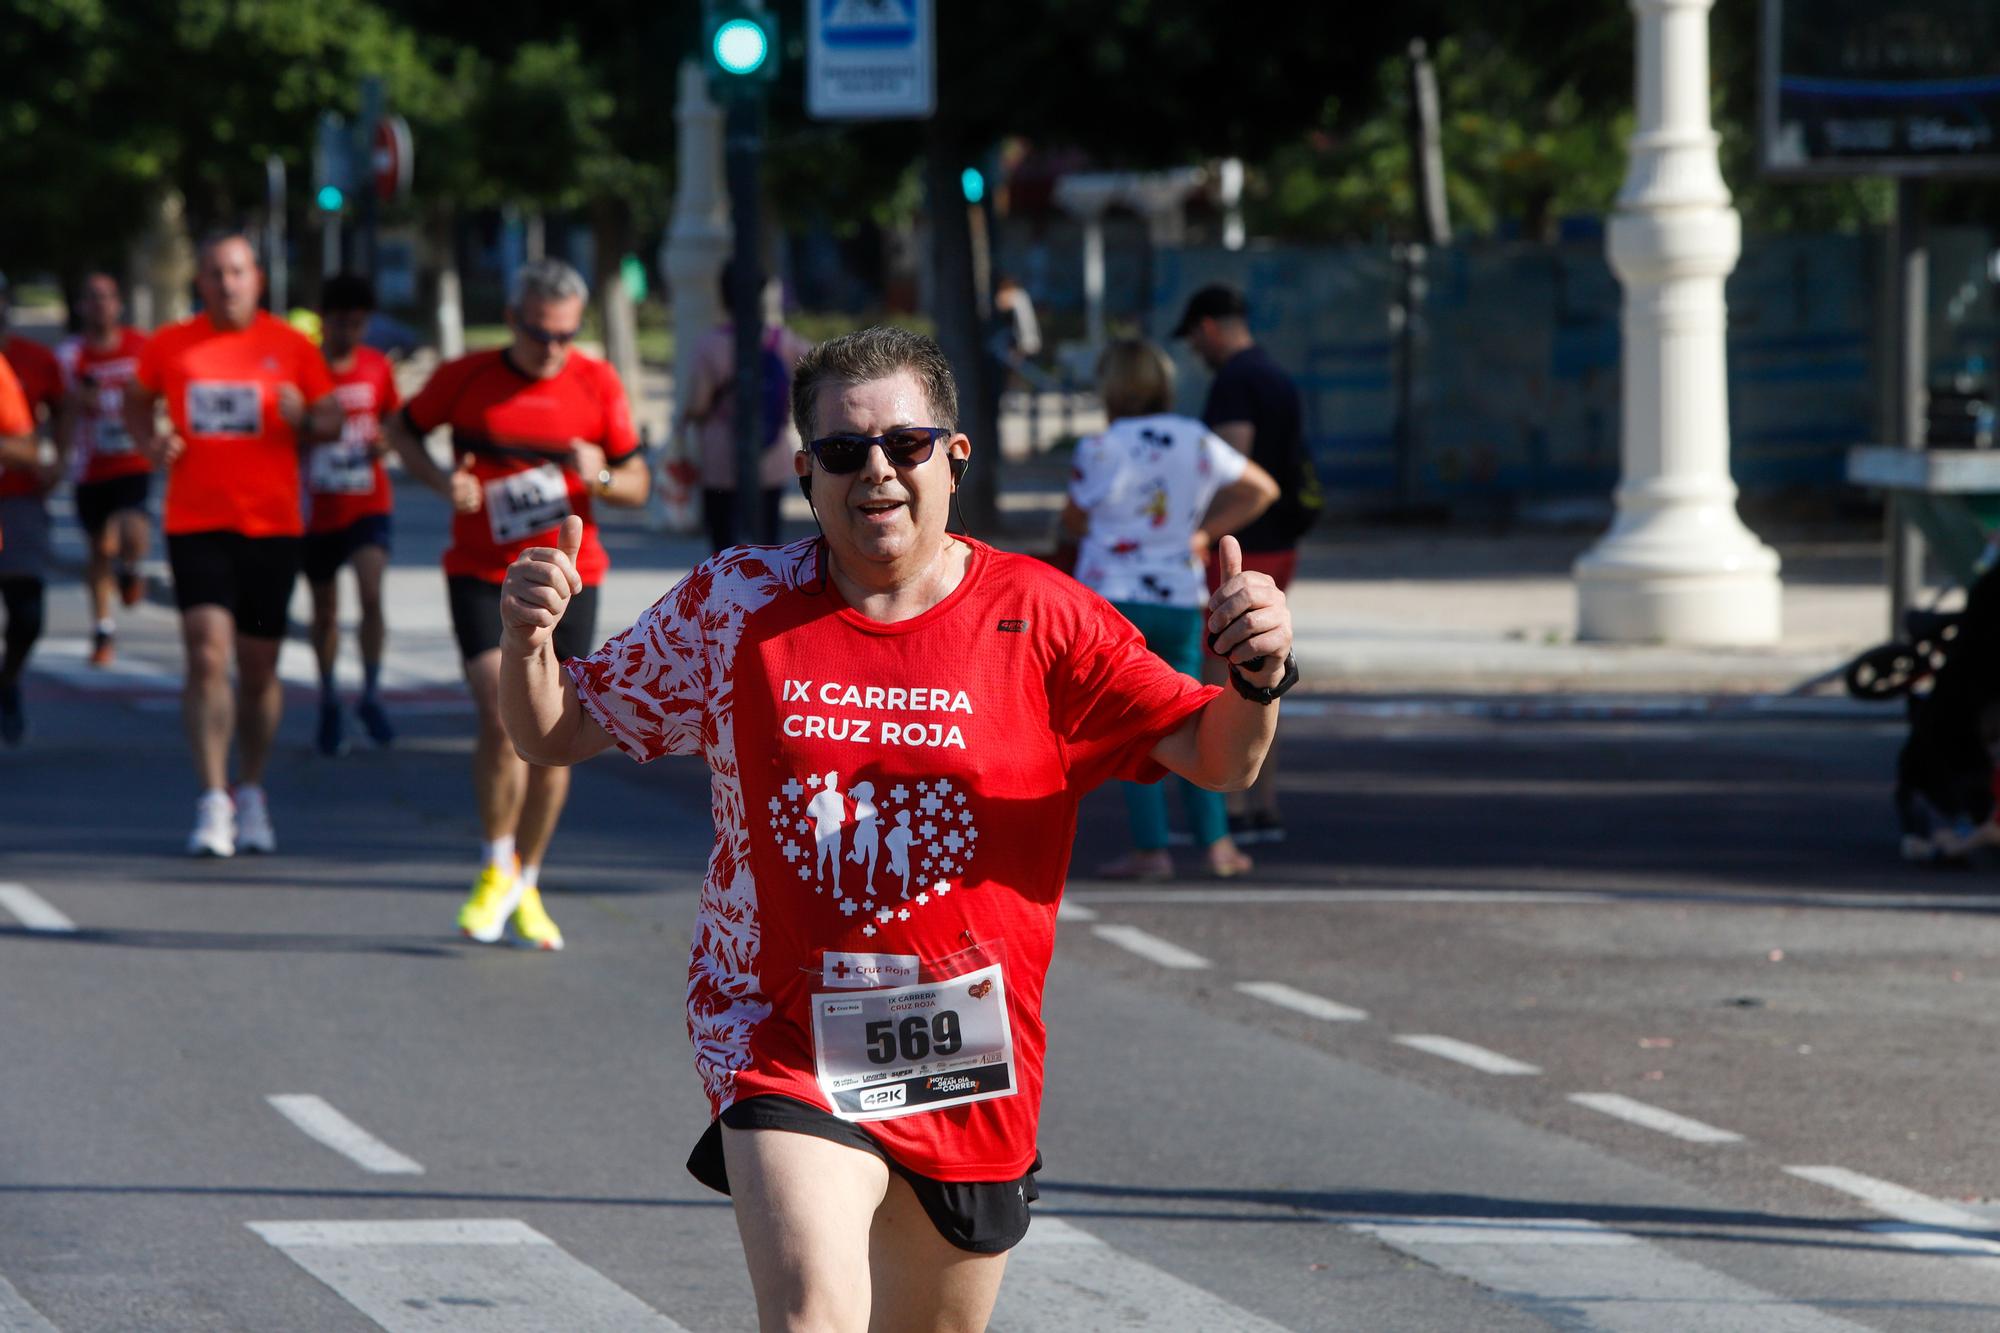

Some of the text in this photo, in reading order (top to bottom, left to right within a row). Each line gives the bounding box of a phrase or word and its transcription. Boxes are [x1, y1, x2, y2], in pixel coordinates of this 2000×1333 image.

[782, 679, 973, 714] IX CARRERA
[783, 715, 966, 749] CRUZ ROJA
[855, 965, 910, 976] Cruz Roja
[888, 992, 937, 1005] IX CARRERA
[890, 1001, 936, 1012] CRUZ ROJA
[865, 1010, 963, 1065] 569
[864, 1088, 903, 1104] 42K
